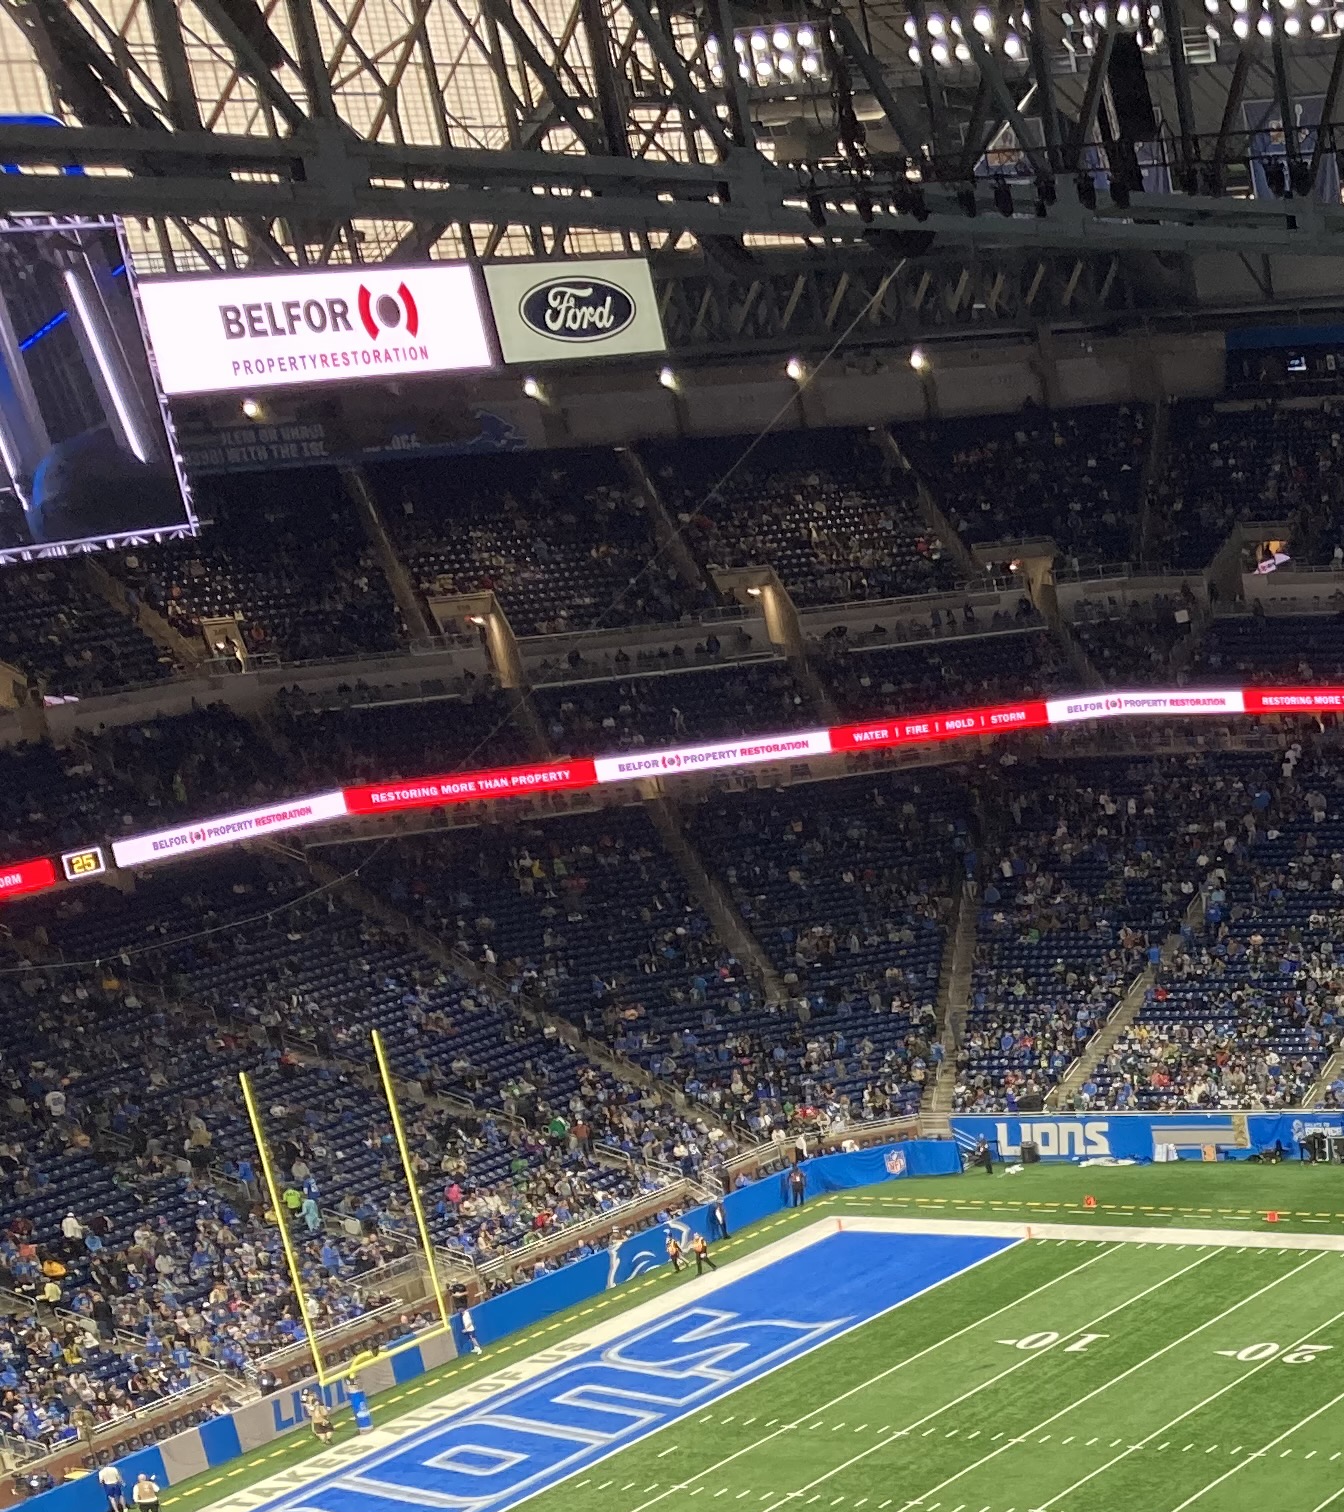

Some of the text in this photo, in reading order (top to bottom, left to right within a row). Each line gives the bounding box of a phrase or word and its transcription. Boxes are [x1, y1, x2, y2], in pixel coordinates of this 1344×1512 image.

[218, 296, 354, 341] BELFOR
[544, 286, 616, 332] Ford
[1066, 702, 1103, 714] BELFOR
[1123, 698, 1168, 709] PROPERTY
[1261, 695, 1312, 706] RESTORING
[1312, 695, 1342, 706] MORE
[853, 710, 1026, 743] WATER FIRE MOLD STORM
[618, 740, 810, 774] BELFOR PROPERTY RESTORATION
[370, 770, 571, 804] RESTORING MORE THAN PROPERTY
[152, 805, 313, 852] BELFOR PROPERTY RESTORATION
[71, 852, 96, 874] 25
[994, 1122, 1110, 1156] LIONS
[1014, 1328, 1112, 1352] 10
[1234, 1340, 1334, 1364] 20
[220, 1442, 376, 1510] TAKES
[386, 1390, 478, 1438] ALL
[479, 1367, 528, 1394] OF
[536, 1340, 592, 1364] US
